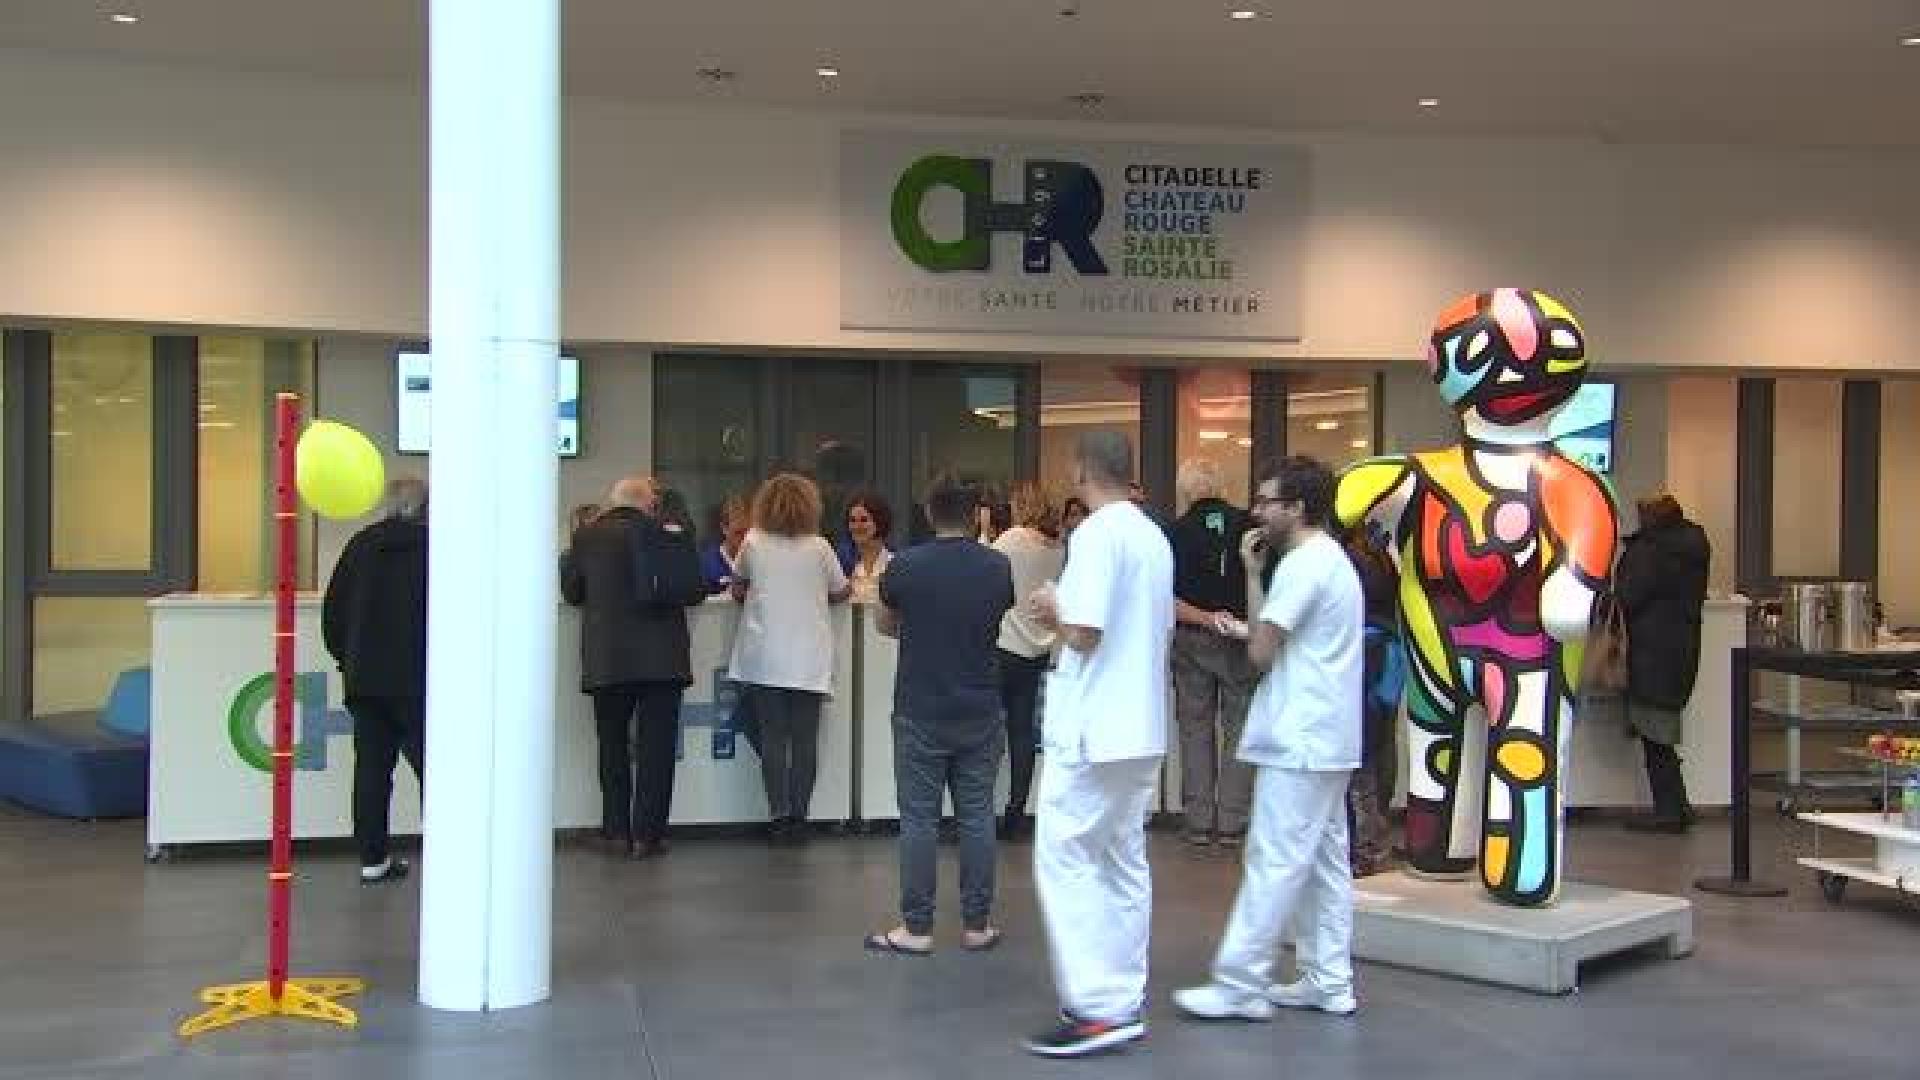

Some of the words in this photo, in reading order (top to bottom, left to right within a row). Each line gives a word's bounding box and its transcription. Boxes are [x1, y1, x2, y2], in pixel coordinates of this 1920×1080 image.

[1124, 165, 1261, 189] CITADELLE
[1124, 190, 1245, 213] CHATEAU
[890, 153, 1109, 276] CHR
[1124, 213, 1210, 234] ROUGE
[1124, 236, 1216, 258] SAINTE
[1124, 258, 1234, 280] ROSALIE
